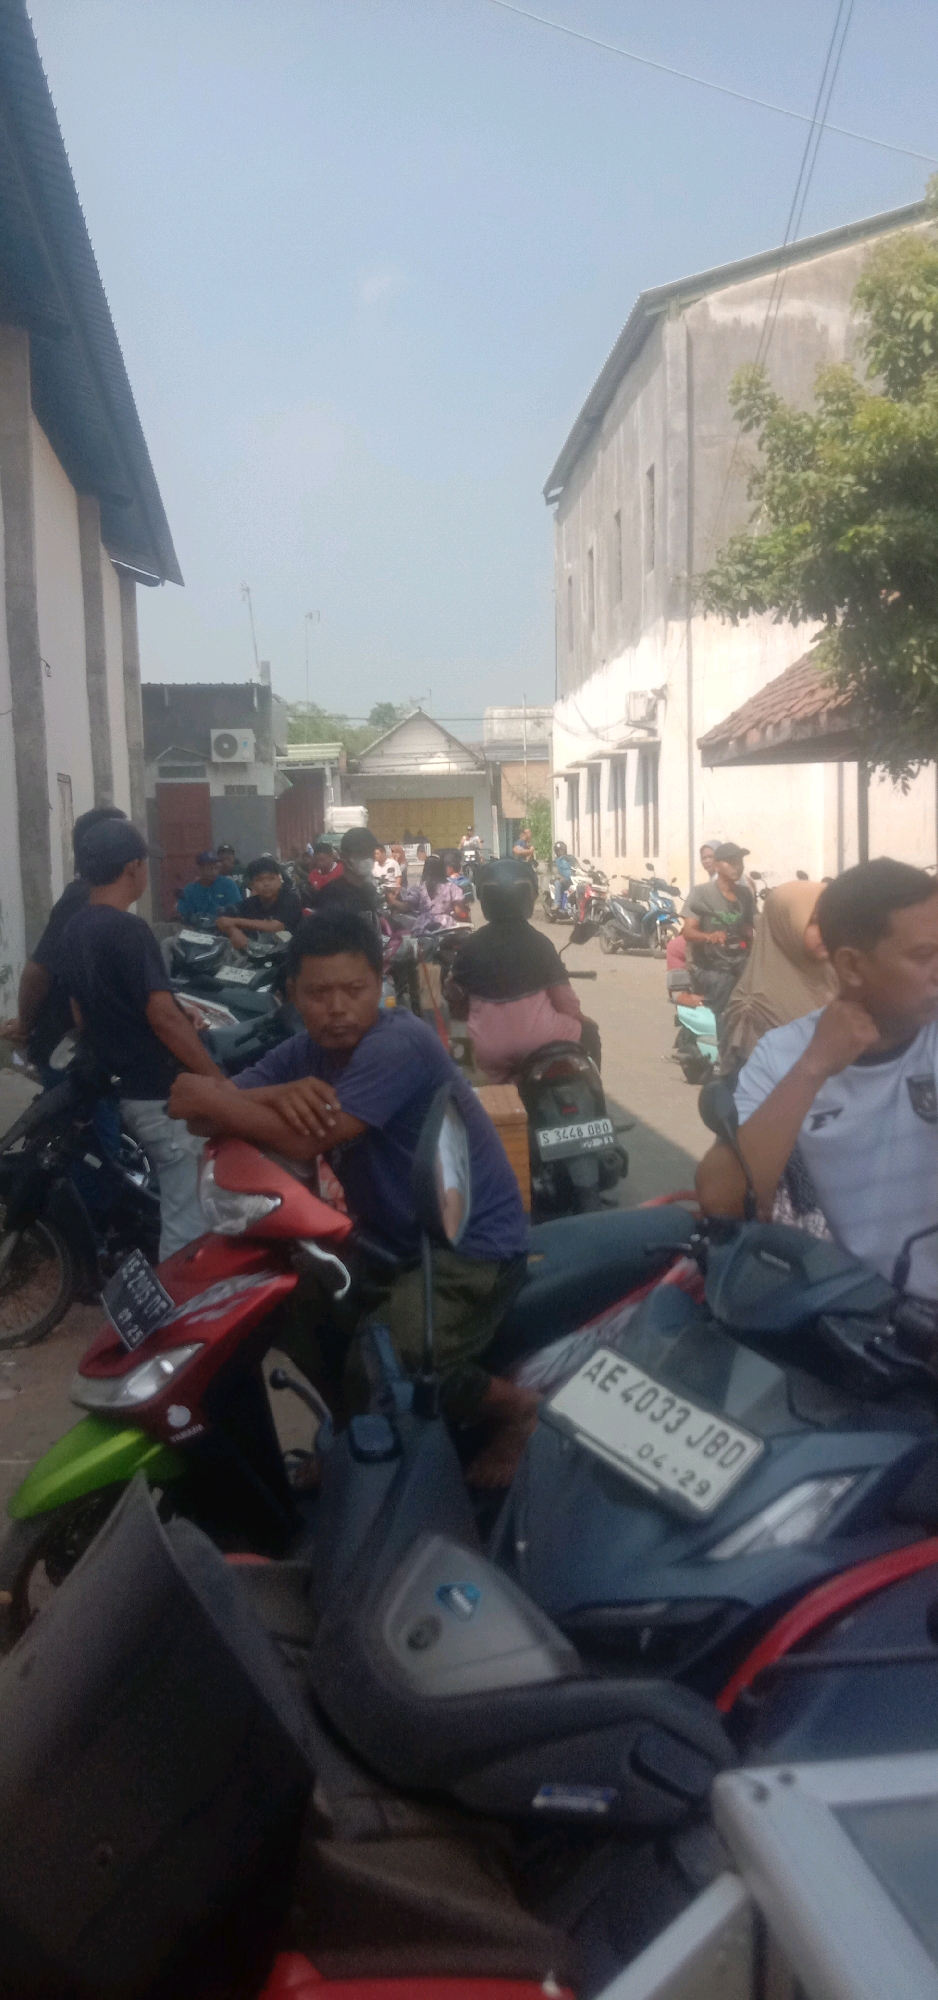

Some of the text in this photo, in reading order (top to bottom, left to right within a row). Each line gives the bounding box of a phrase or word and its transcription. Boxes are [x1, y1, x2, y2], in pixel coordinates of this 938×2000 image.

[542, 1132, 550, 1144] S
[582, 1356, 747, 1469] AE 4033 JBD
